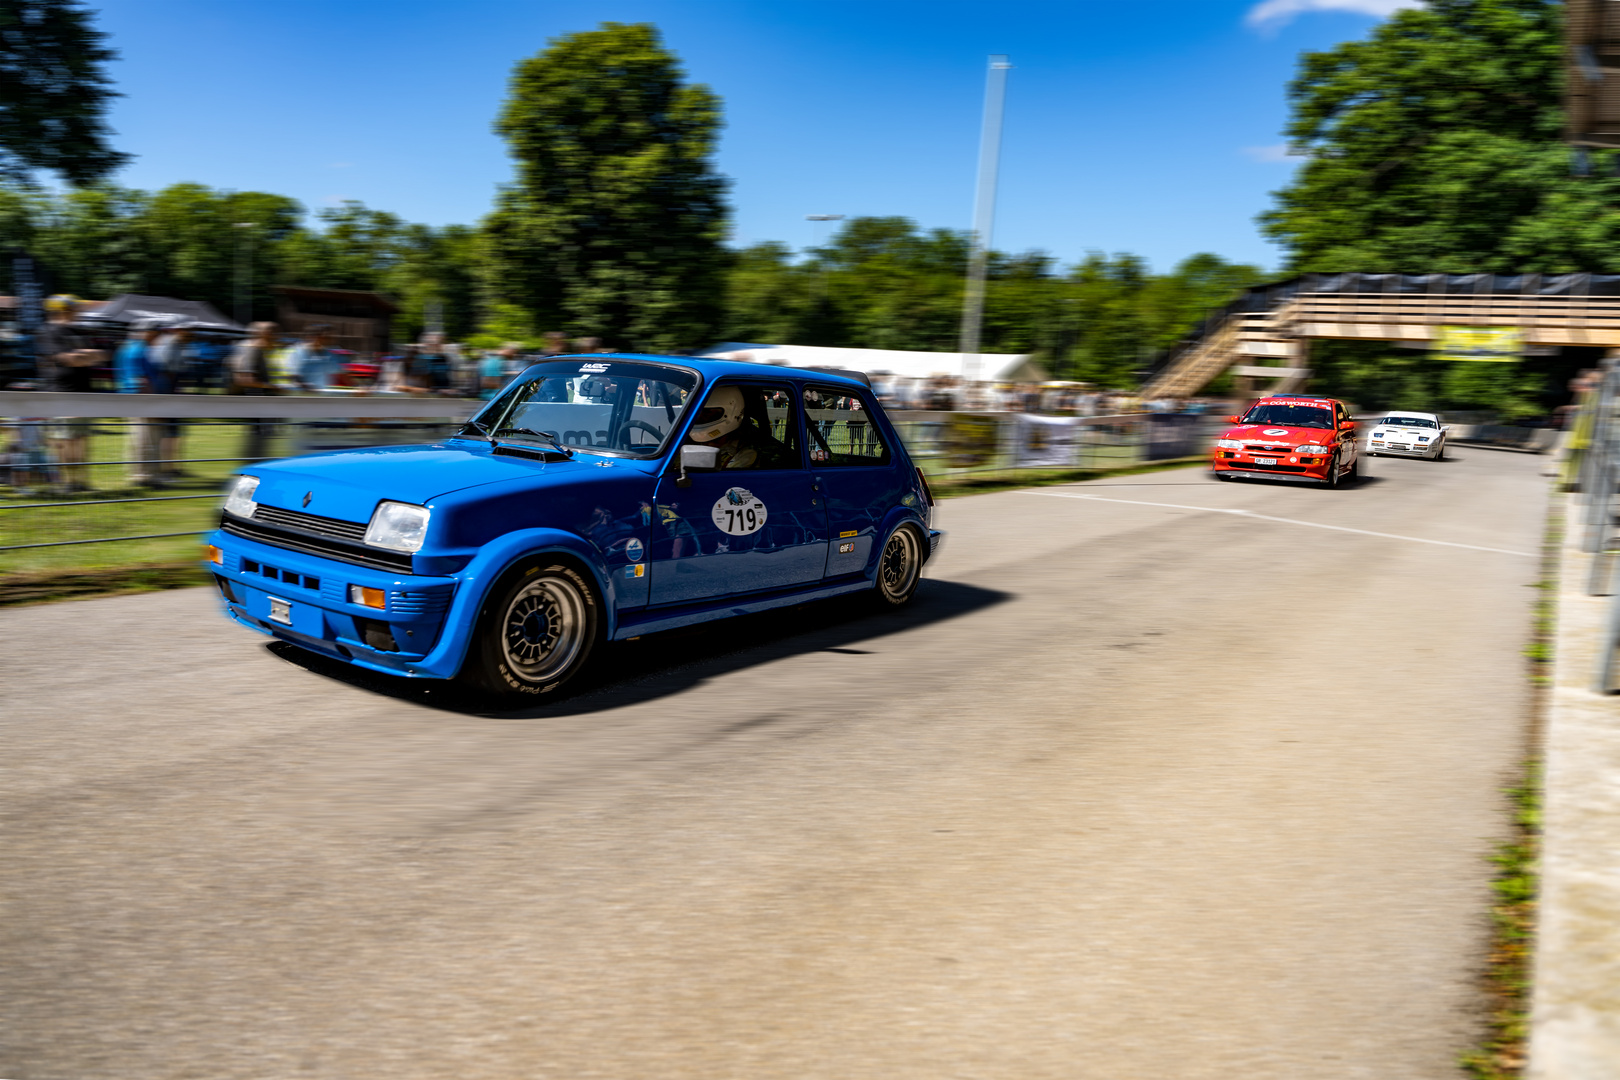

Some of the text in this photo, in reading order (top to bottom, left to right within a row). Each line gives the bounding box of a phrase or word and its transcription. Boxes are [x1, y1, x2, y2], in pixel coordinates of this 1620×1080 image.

[724, 508, 757, 533] 719
[839, 543, 850, 553] elf
[563, 568, 595, 606] MICHELIN
